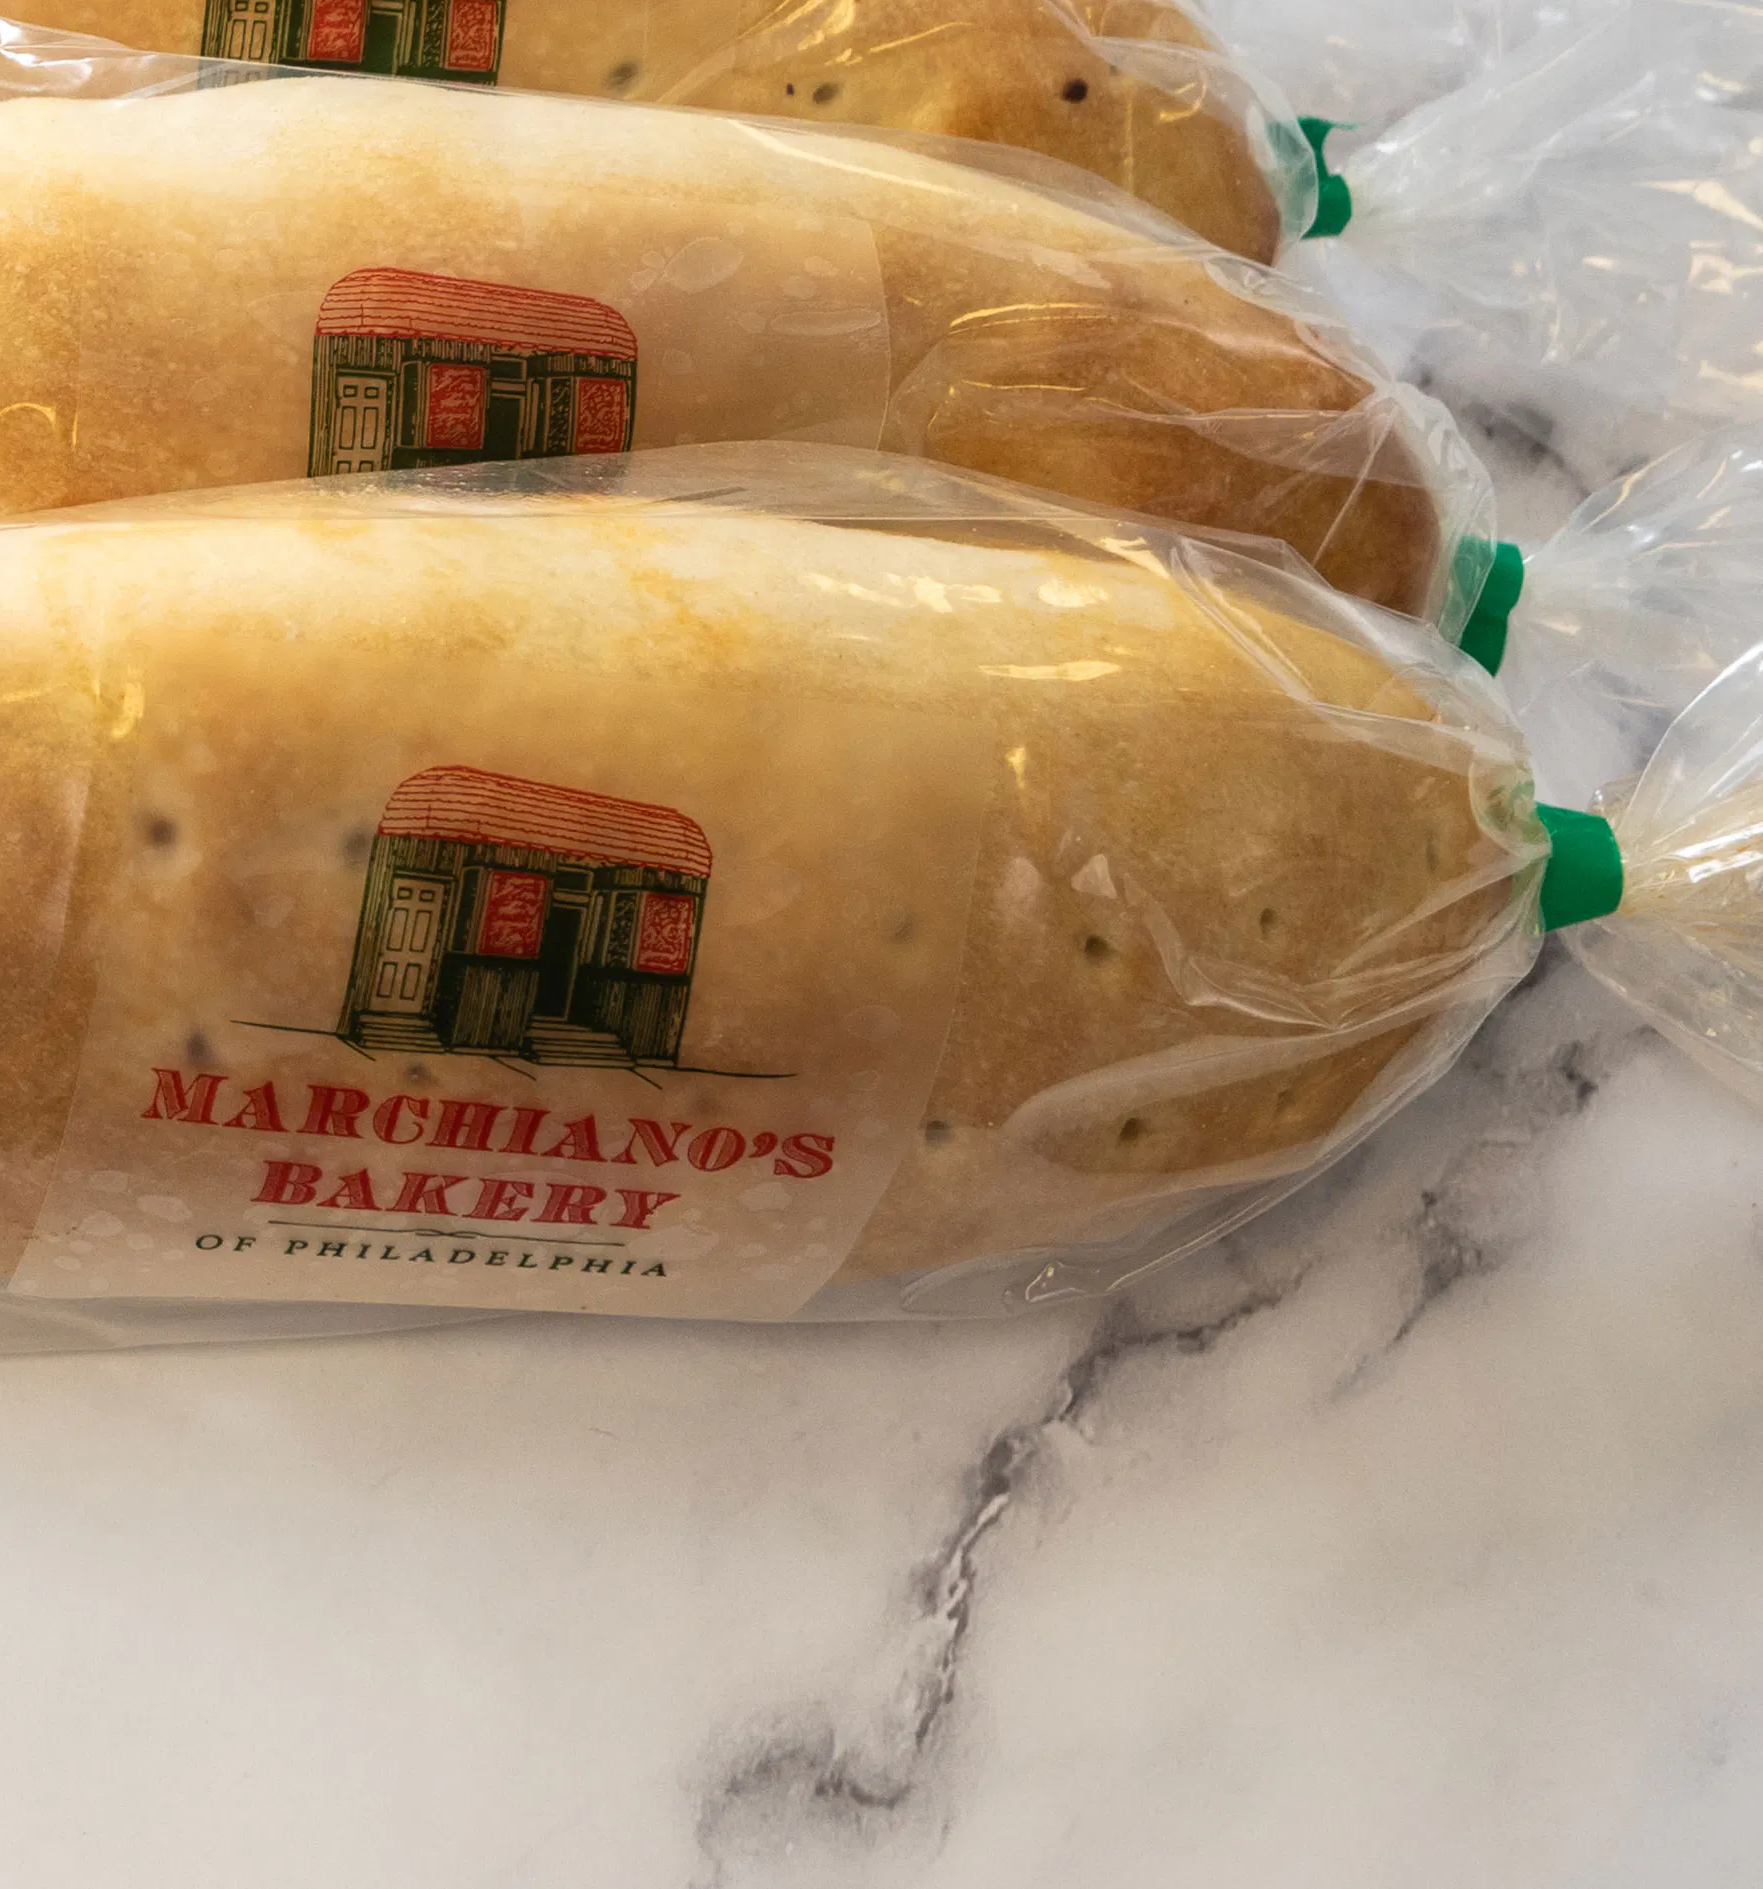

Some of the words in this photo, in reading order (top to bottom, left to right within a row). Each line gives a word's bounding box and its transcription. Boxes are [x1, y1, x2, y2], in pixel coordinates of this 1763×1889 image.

[141, 1066, 836, 1180] MARCHIANO'S
[250, 1159, 682, 1231] BAKERY
[196, 1234, 257, 1253] OF
[284, 1238, 668, 1278] PHILADELPHIA
